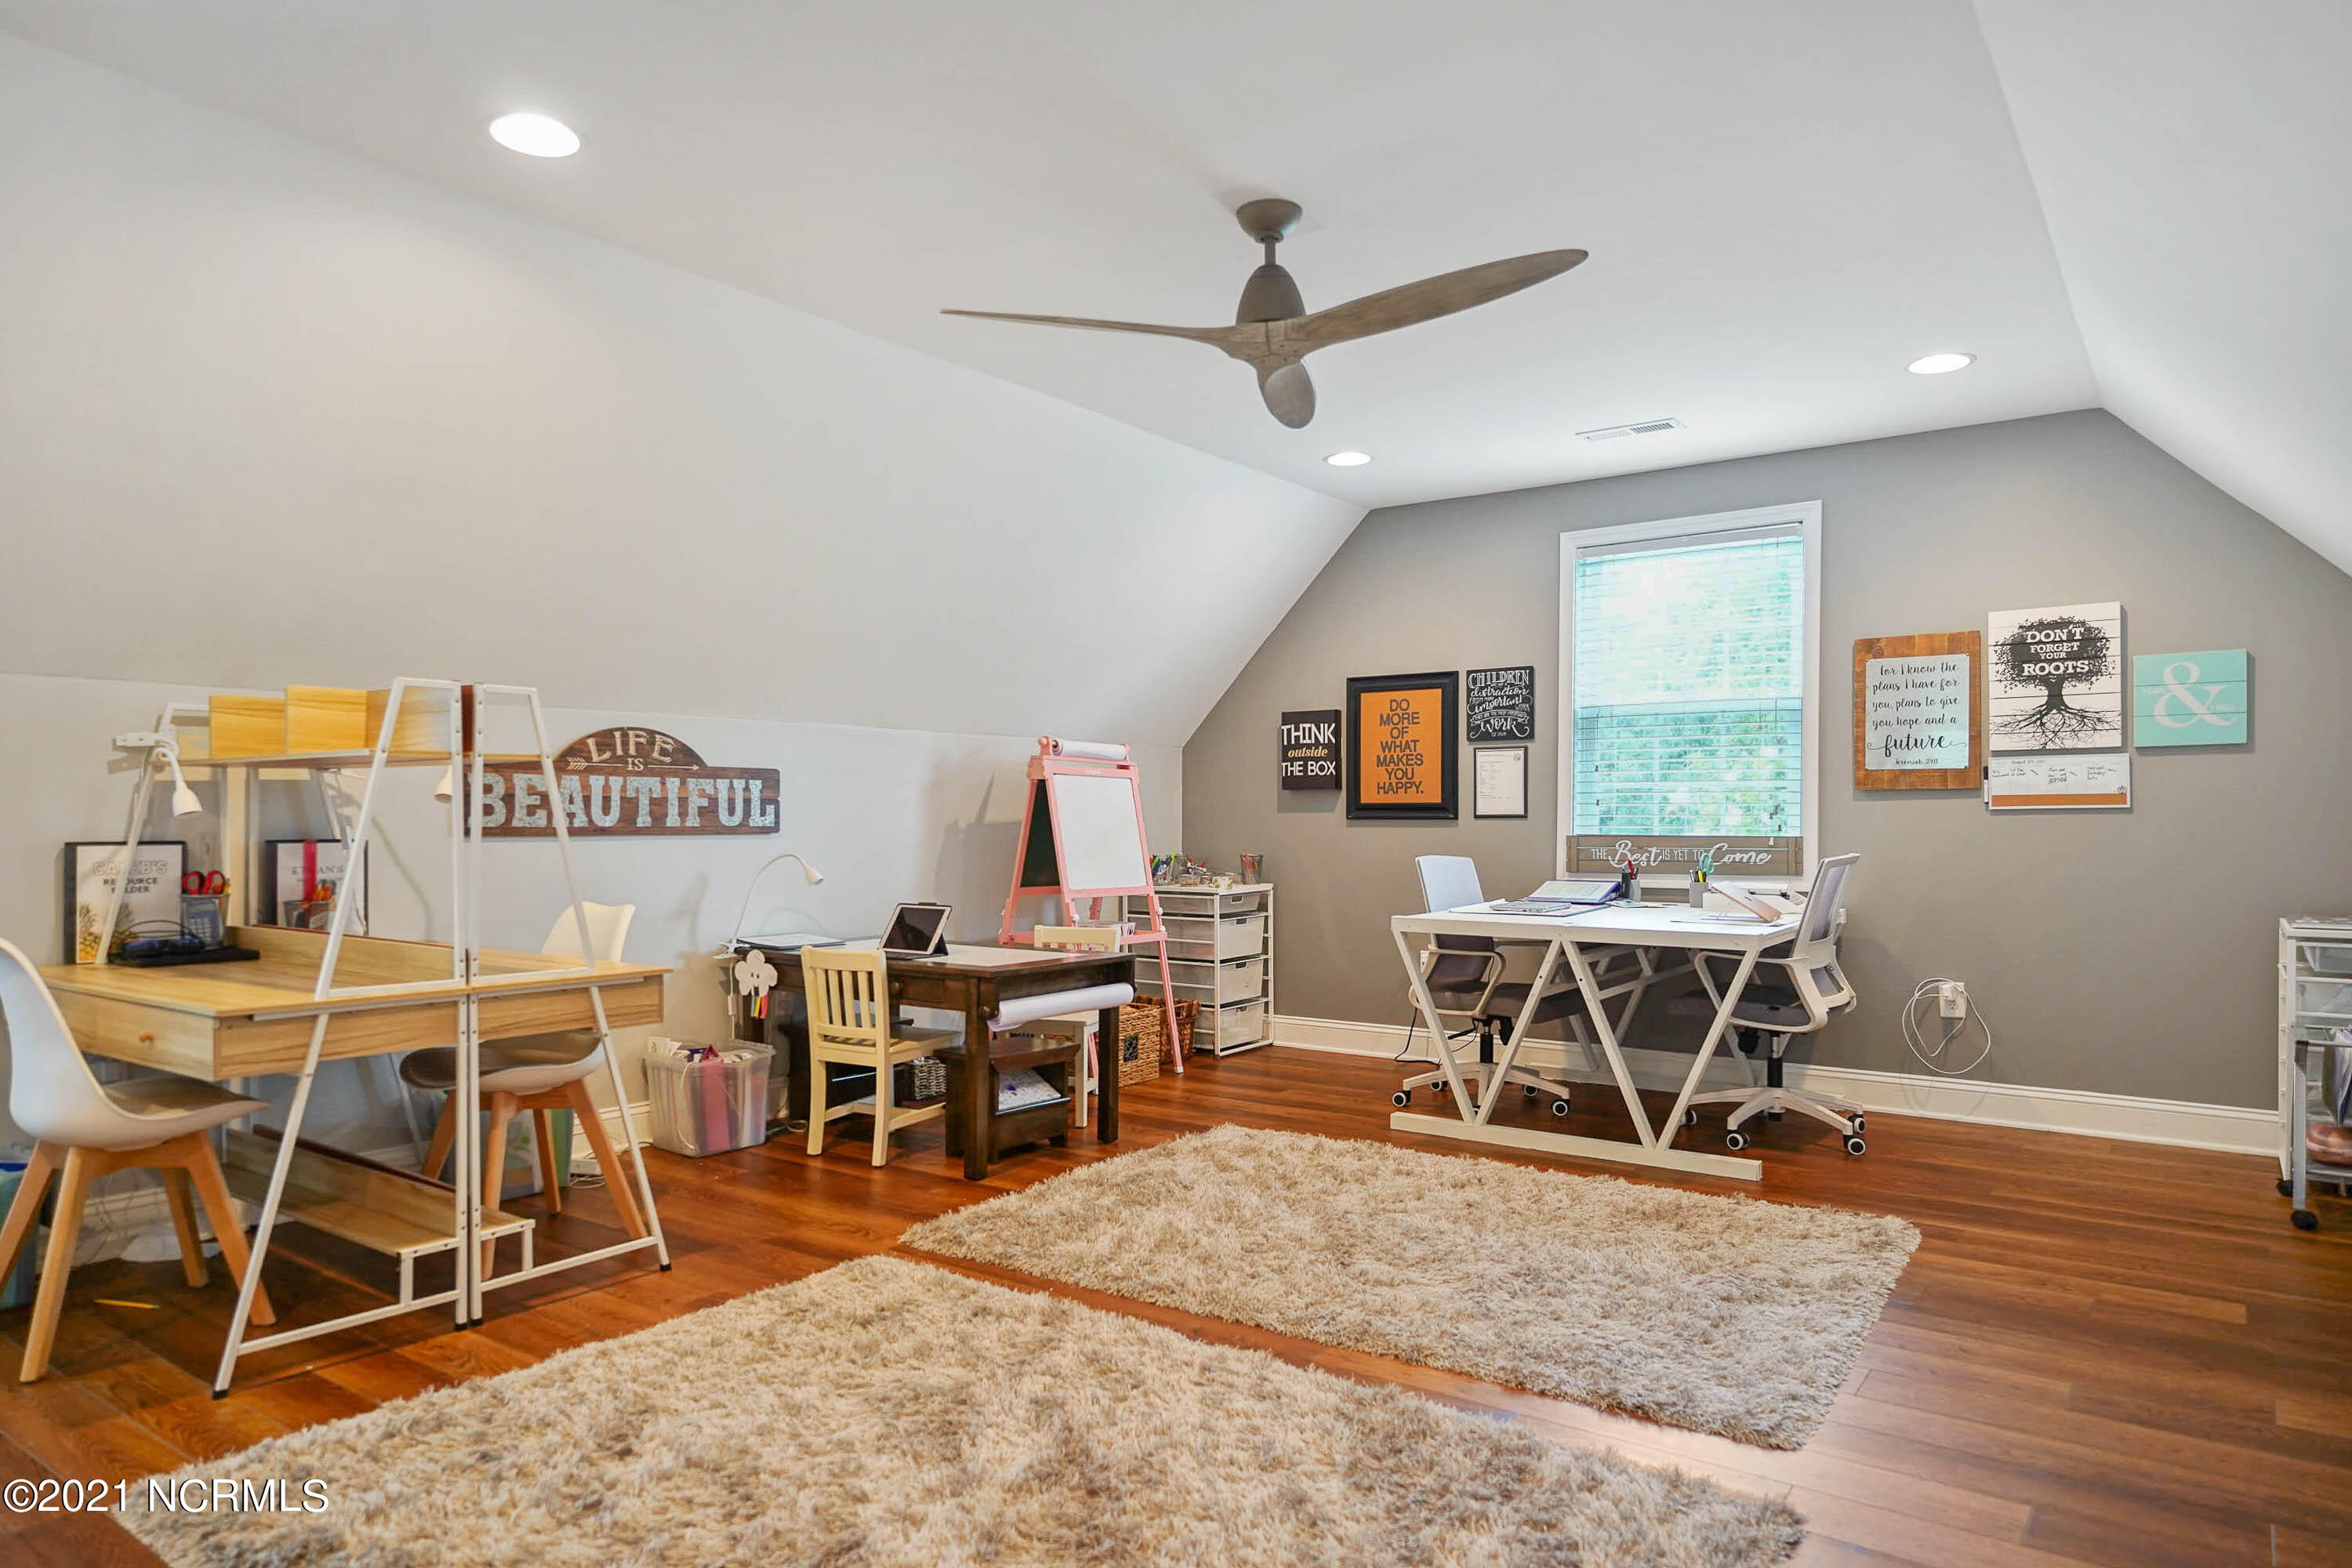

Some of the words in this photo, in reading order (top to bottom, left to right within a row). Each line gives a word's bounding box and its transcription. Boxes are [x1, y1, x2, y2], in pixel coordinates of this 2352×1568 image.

[2025, 624, 2084, 643] DON'T
[2030, 642, 2080, 653] FORGET
[1907, 664, 1936, 674] know
[1940, 662, 1958, 673] the
[2022, 660, 2089, 676] ROOTS
[1468, 670, 1529, 688] CHILDREN
[1872, 681, 1900, 695] plans
[1911, 679, 1936, 690] have
[1940, 677, 1959, 691] for
[1471, 685, 1530, 697] distraction
[1389, 699, 1410, 712] DO
[1467, 694, 1522, 714] important
[1896, 698, 1922, 712] plans
[1926, 696, 1936, 706] to
[1940, 695, 1960, 709] give
[1379, 711, 1420, 727] MORE
[1872, 718, 1893, 731] you
[1896, 717, 1921, 729] hope
[1925, 713, 1945, 724] and
[1281, 723, 1335, 746] THINK
[1390, 726, 1409, 739] OF
[586, 730, 676, 763] LIFE
[1288, 746, 1328, 758] outside
[1380, 739, 1420, 753] WHAT
[1882, 733, 1952, 757] future
[627, 757, 644, 771] IS
[1281, 761, 1304, 777] THE
[1308, 760, 1336, 776] BOX
[1377, 753, 1424, 768] MAKES
[1385, 767, 1414, 780] YOU
[1377, 781, 1424, 795] HAPPY.
[468, 773, 775, 828] BEAUTIFUL
[1591, 848, 1608, 860] THE
[1608, 840, 1662, 868] Best
[1662, 849, 1670, 860] IS
[1673, 849, 1688, 861] YET
[1708, 843, 1772, 866] Come
